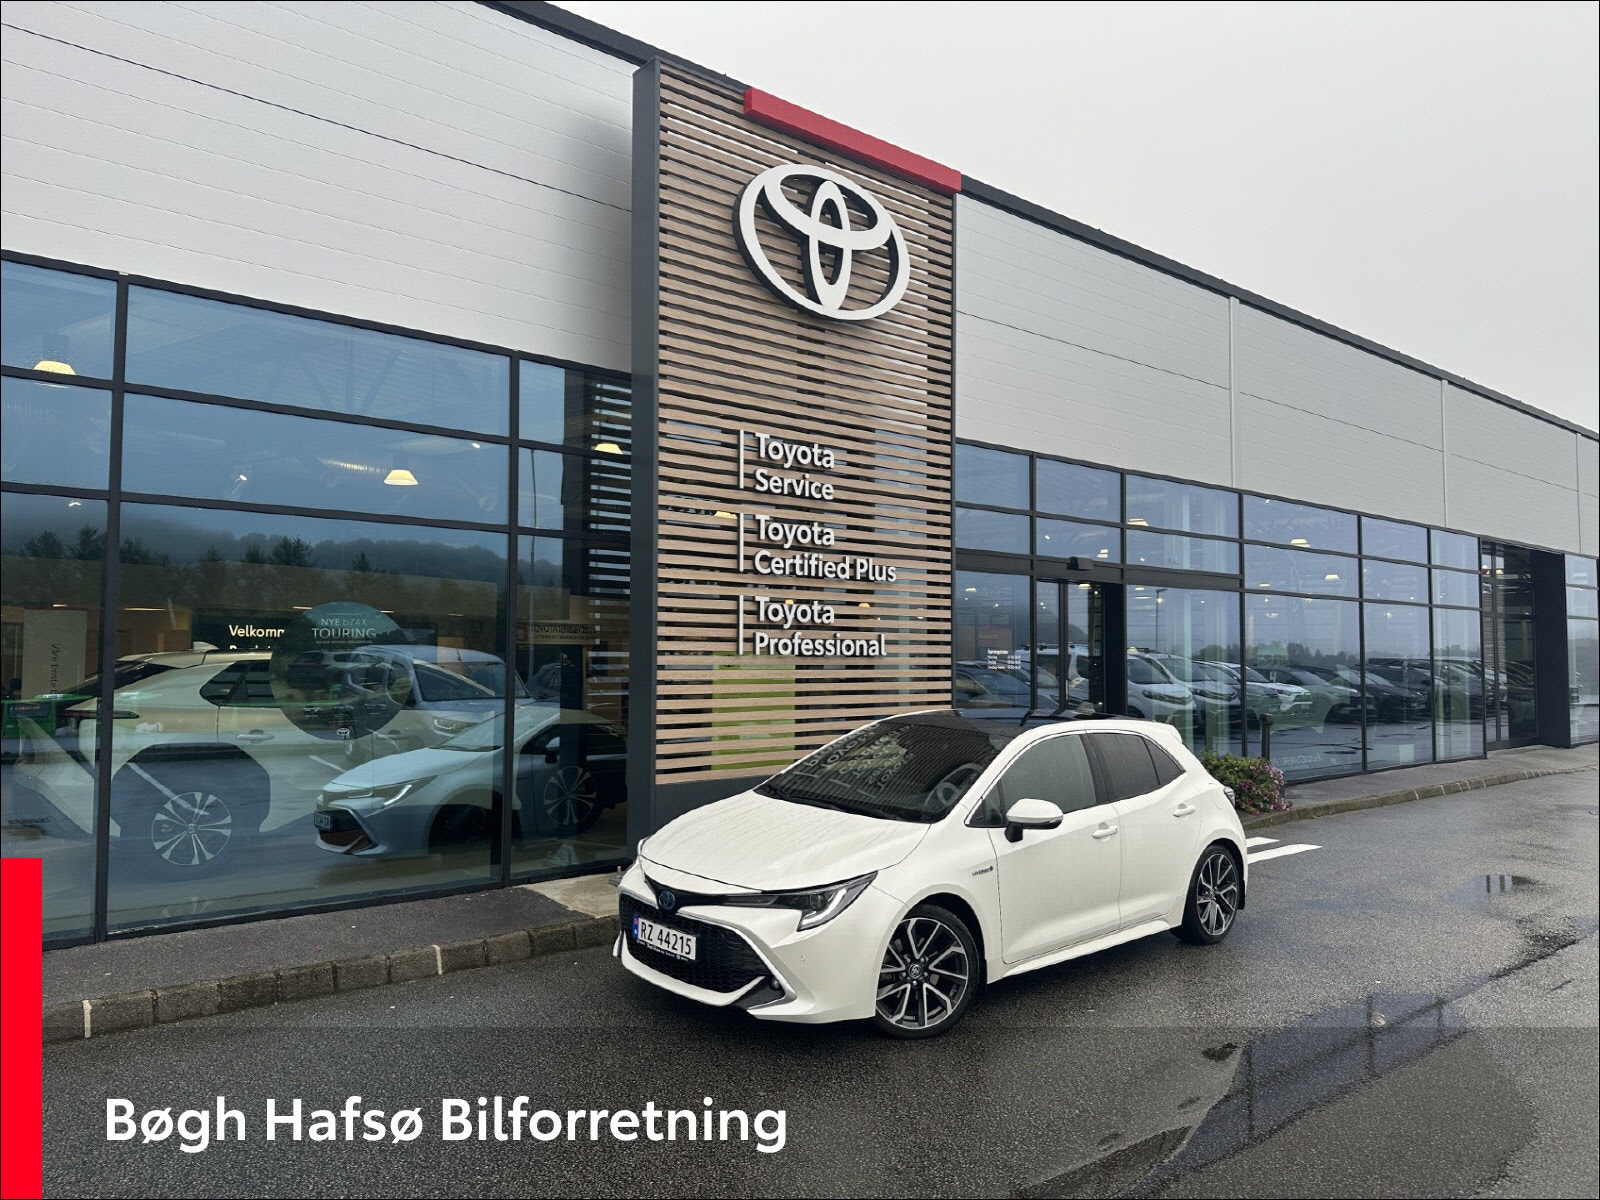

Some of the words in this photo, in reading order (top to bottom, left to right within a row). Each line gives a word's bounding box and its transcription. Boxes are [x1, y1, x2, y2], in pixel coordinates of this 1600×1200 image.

[755, 432, 835, 468] Toyota
[755, 469, 835, 500] Service
[755, 514, 835, 548] Toyota
[754, 550, 850, 580] Certified
[855, 558, 897, 582] Plus
[321, 618, 340, 626] NYE
[755, 596, 835, 629] Toyota
[311, 628, 376, 639] TOURING
[755, 632, 887, 656] Professional
[641, 921, 653, 942] RZ
[657, 928, 692, 955] 44215
